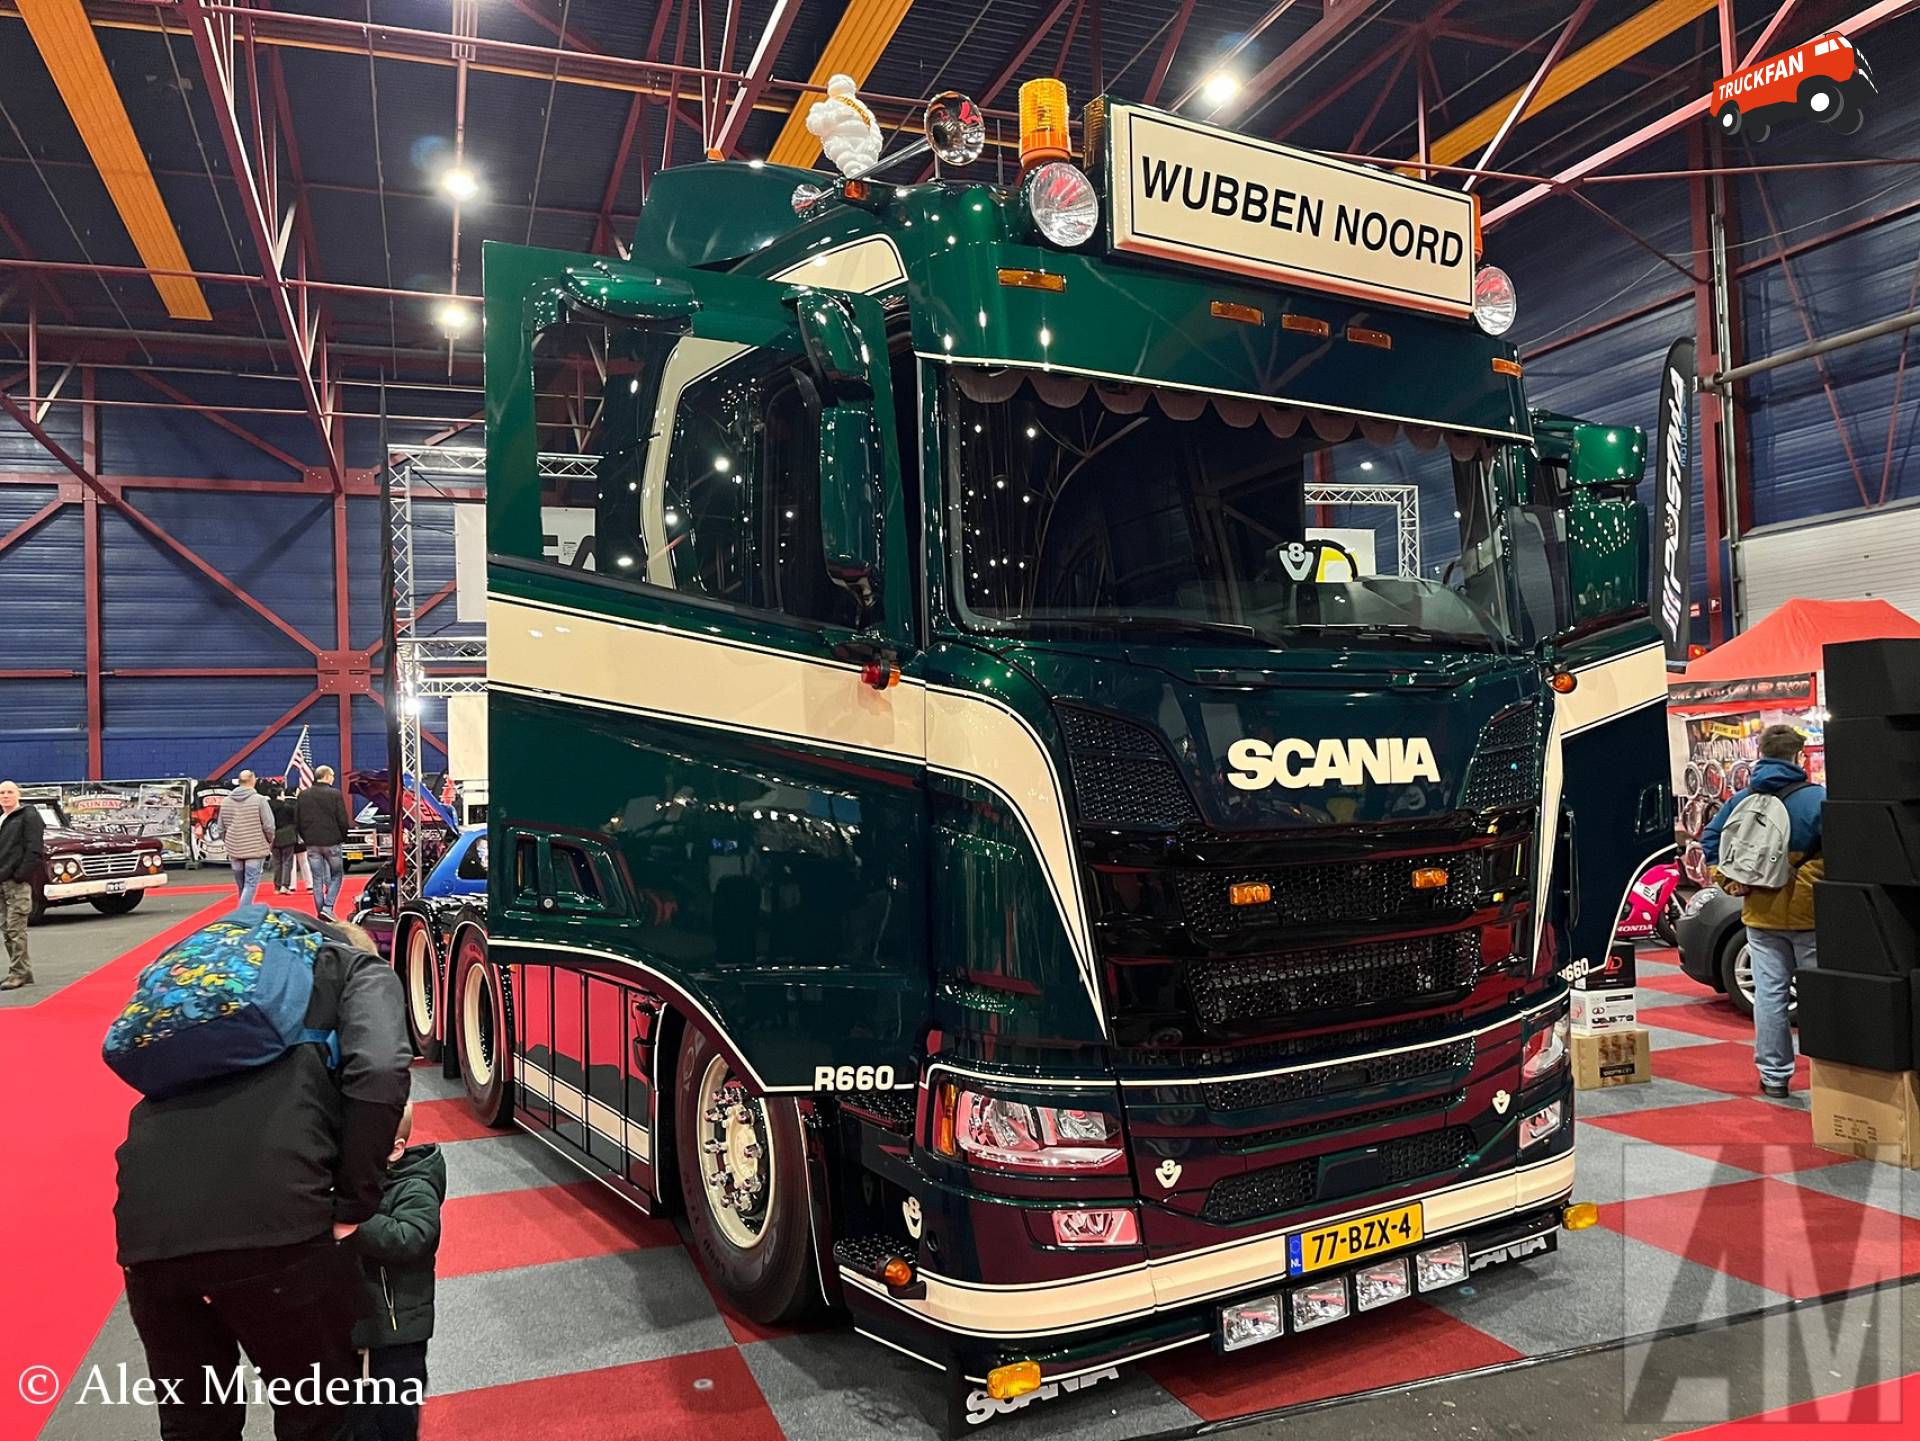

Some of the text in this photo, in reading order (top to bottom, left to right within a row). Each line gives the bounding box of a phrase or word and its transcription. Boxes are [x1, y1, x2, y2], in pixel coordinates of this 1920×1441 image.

[1141, 155, 1464, 268] WUBBEN NOORD
[1227, 737, 1441, 791] SCANIA
[813, 1065, 895, 1092] R660
[1290, 1212, 1412, 1268] NL 77-BZX-4
